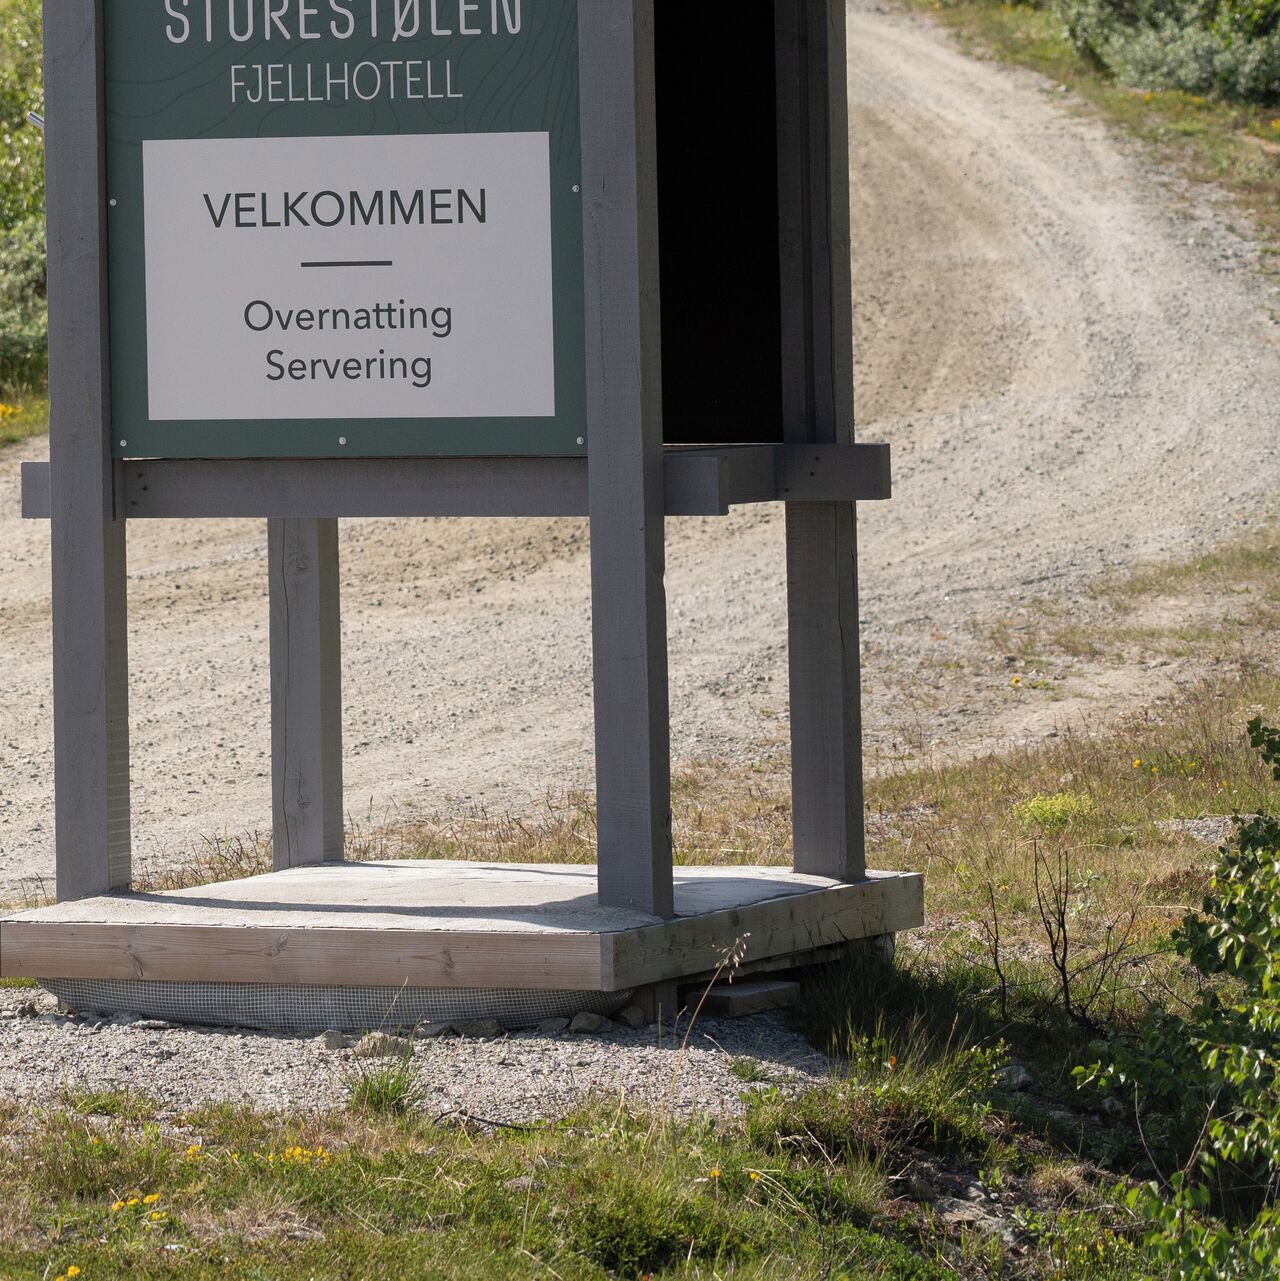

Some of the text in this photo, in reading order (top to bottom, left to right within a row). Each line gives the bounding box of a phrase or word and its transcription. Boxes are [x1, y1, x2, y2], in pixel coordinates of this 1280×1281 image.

[230, 59, 464, 103] FJELLHOTELL
[203, 188, 487, 228] VELKOMMEN
[243, 299, 453, 339] Overnatting
[266, 348, 432, 388] Servering
